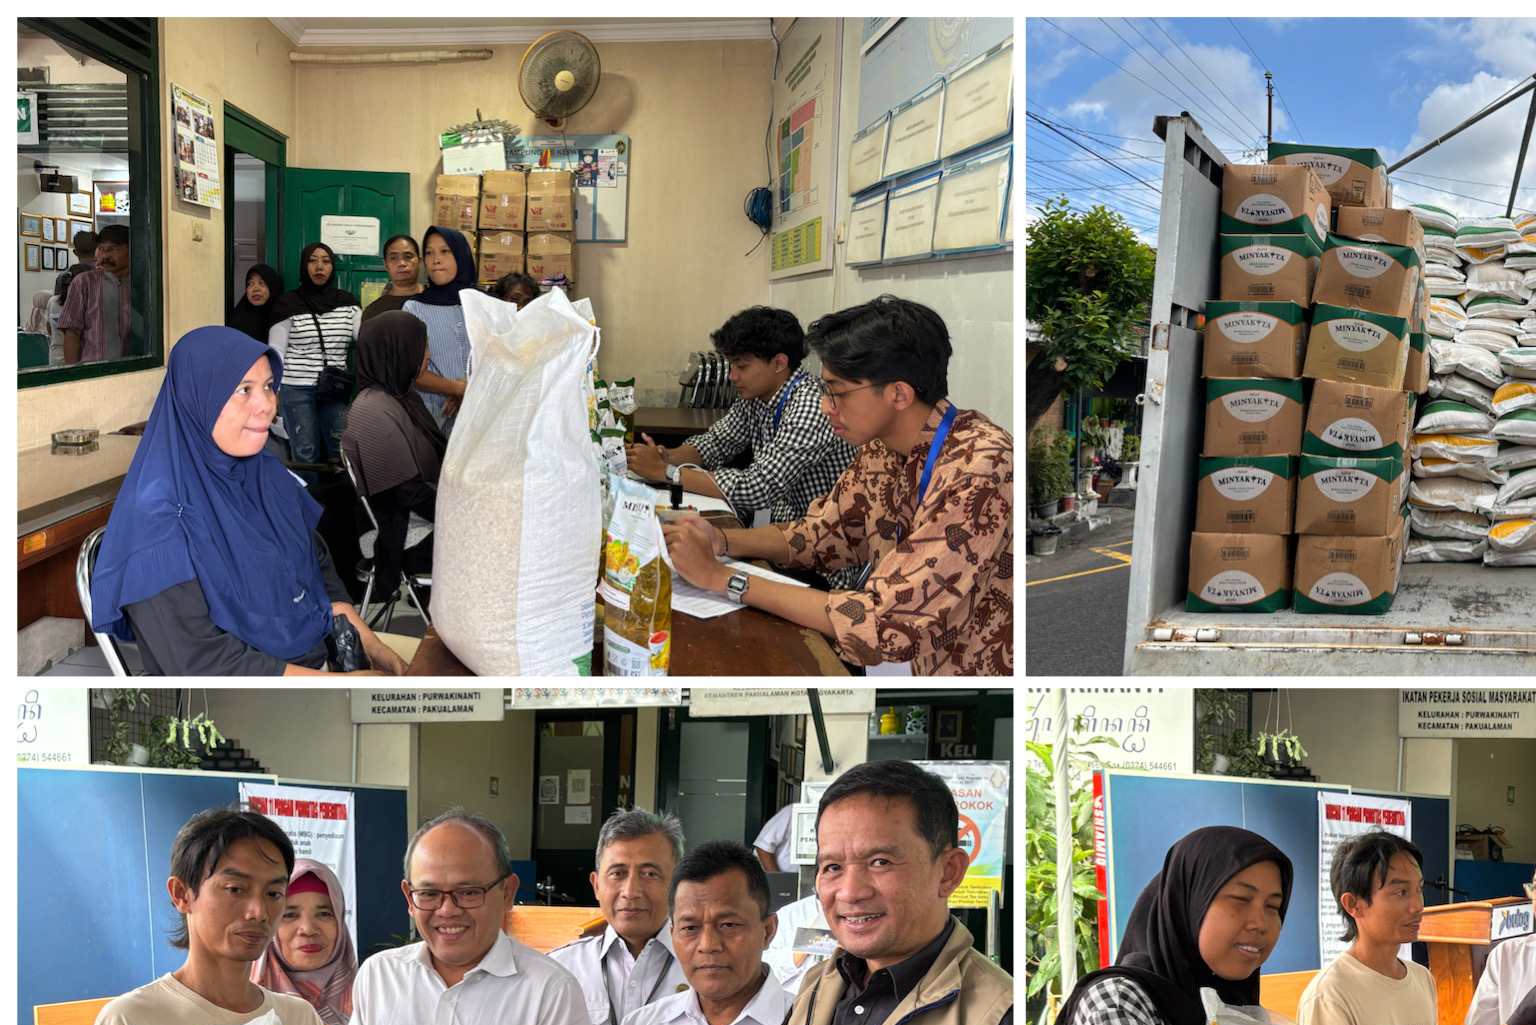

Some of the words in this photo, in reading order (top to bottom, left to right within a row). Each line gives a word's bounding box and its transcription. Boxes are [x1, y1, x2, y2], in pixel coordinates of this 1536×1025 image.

[371, 693, 417, 701] KELURAHAN
[422, 692, 481, 701] PURWAKINANTI
[745, 690, 790, 698] PAKUALAMAN
[1402, 691, 1427, 703] IKATAN
[1429, 691, 1460, 703] PEKERJA
[1462, 691, 1487, 703] SOSIAL
[1489, 691, 1536, 704] MASYARAKAT
[371, 705, 417, 714] KECAMATAN
[422, 705, 474, 714] PAKUALAMAN
[1418, 711, 1460, 719] KELURAHAN
[1465, 711, 1520, 719] PURWAKINANTI
[1418, 722, 1459, 730] KECAMATAN
[42, 752, 72, 762] 544661
[1149, 762, 1177, 771] 544661
[1506, 909, 1530, 931] bulog
